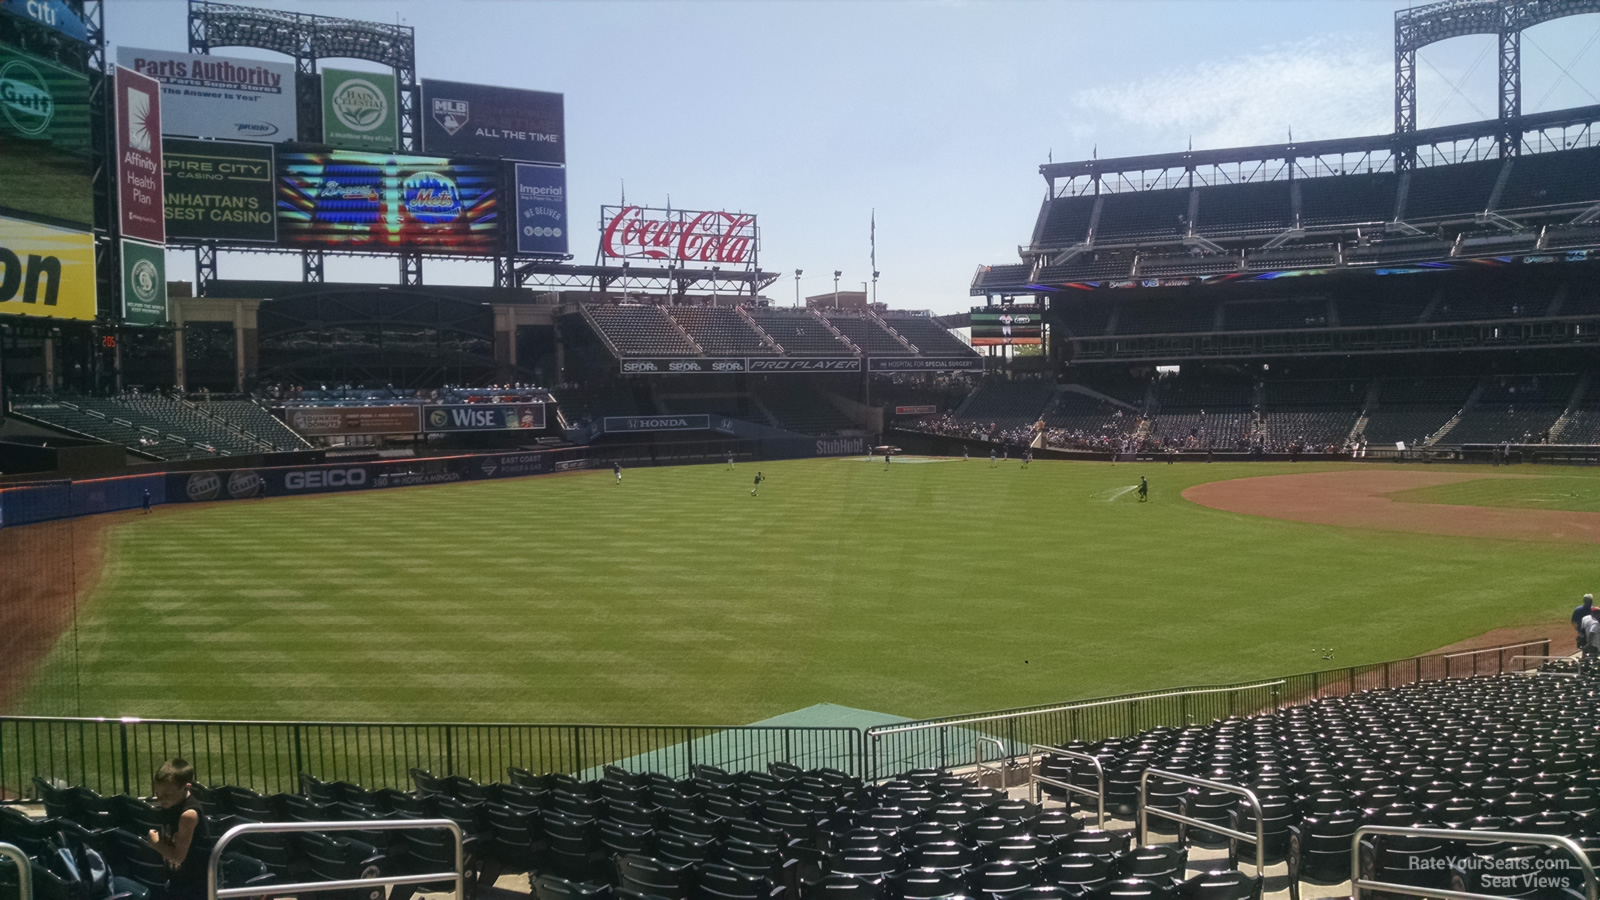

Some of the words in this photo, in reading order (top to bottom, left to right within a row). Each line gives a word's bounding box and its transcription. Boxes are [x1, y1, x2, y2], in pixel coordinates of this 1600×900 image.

[27, 0, 56, 26] citi
[134, 58, 187, 78] Parts
[192, 60, 281, 87] Authority
[169, 77, 201, 86] Parts
[203, 80, 239, 89] Super
[240, 84, 279, 92] Stores
[1, 81, 50, 113] Gulf
[184, 88, 222, 98] Answer
[347, 91, 373, 100] HAIN
[334, 96, 383, 108] CELESTIAL
[434, 100, 466, 112] MLB
[475, 128, 499, 138] ALL
[501, 130, 526, 140] THE
[528, 132, 558, 142] TIME
[124, 151, 157, 174] Affinity
[163, 160, 213, 171] PIRE
[218, 163, 262, 174] CITY
[127, 172, 156, 190] Health
[177, 171, 223, 180] CASINO
[133, 189, 151, 205] Plan
[520, 184, 562, 196] Imperial
[409, 188, 453, 207] Mets
[210, 209, 272, 224] CASINO
[523, 208, 535, 218] WE
[534, 206, 562, 220] DELIVER
[603, 205, 756, 263] Coca-Cola
[750, 360, 787, 369] PRO
[791, 360, 859, 369] PLAYER
[640, 419, 688, 428] HONDA
[816, 438, 863, 454] StubHub!
[520, 455, 541, 463] COAST
[501, 464, 523, 473] POWER
[529, 463, 542, 471] GAS
[230, 475, 260, 494] Gulf
[285, 468, 365, 489] GEICO
[373, 478, 388, 487] 380
[401, 475, 429, 484] KONICA
[430, 473, 460, 481] MINOLTA
[189, 478, 220, 496] Gulf
